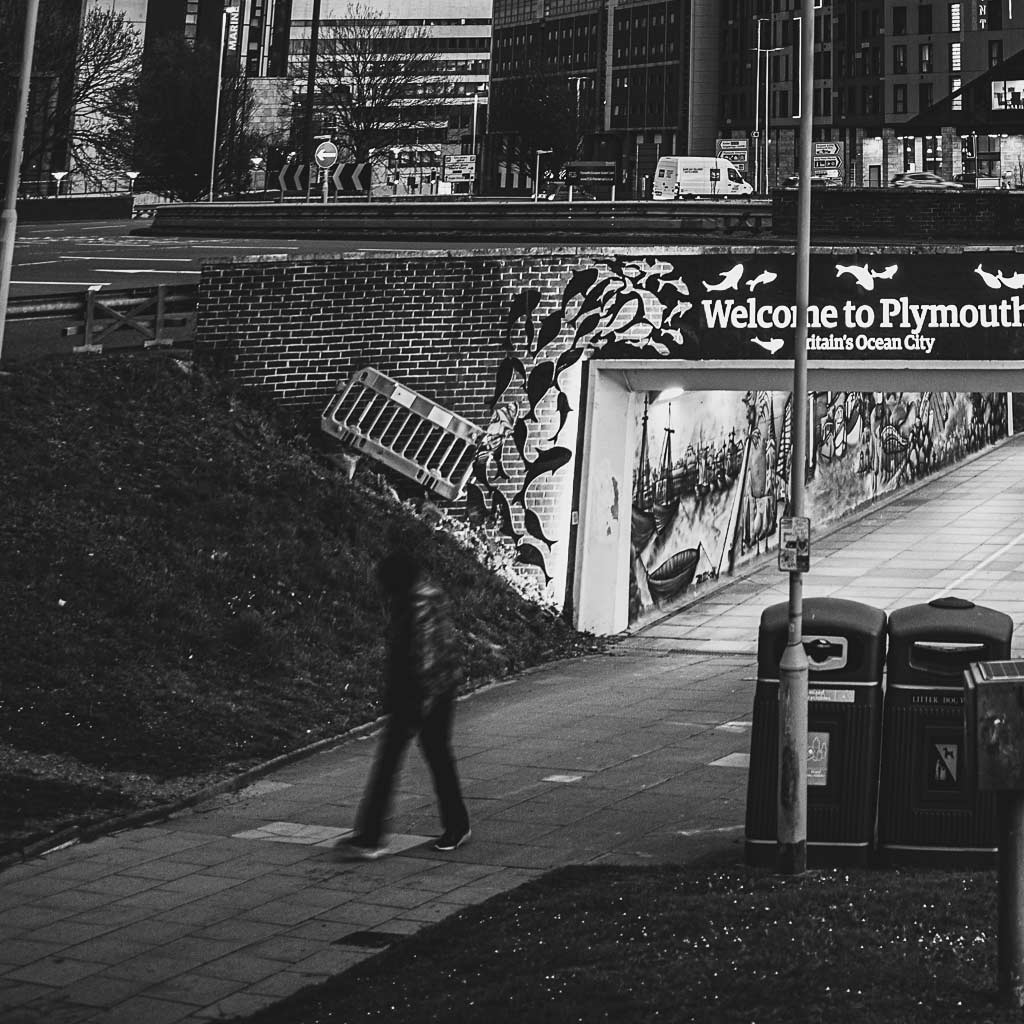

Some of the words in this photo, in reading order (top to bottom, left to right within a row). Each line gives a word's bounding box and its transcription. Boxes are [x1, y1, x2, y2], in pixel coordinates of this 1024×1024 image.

[700, 297, 838, 330] Welcome
[842, 300, 875, 330] to
[806, 333, 854, 351] ritain's
[855, 334, 902, 351] Ocean
[903, 333, 936, 354] City
